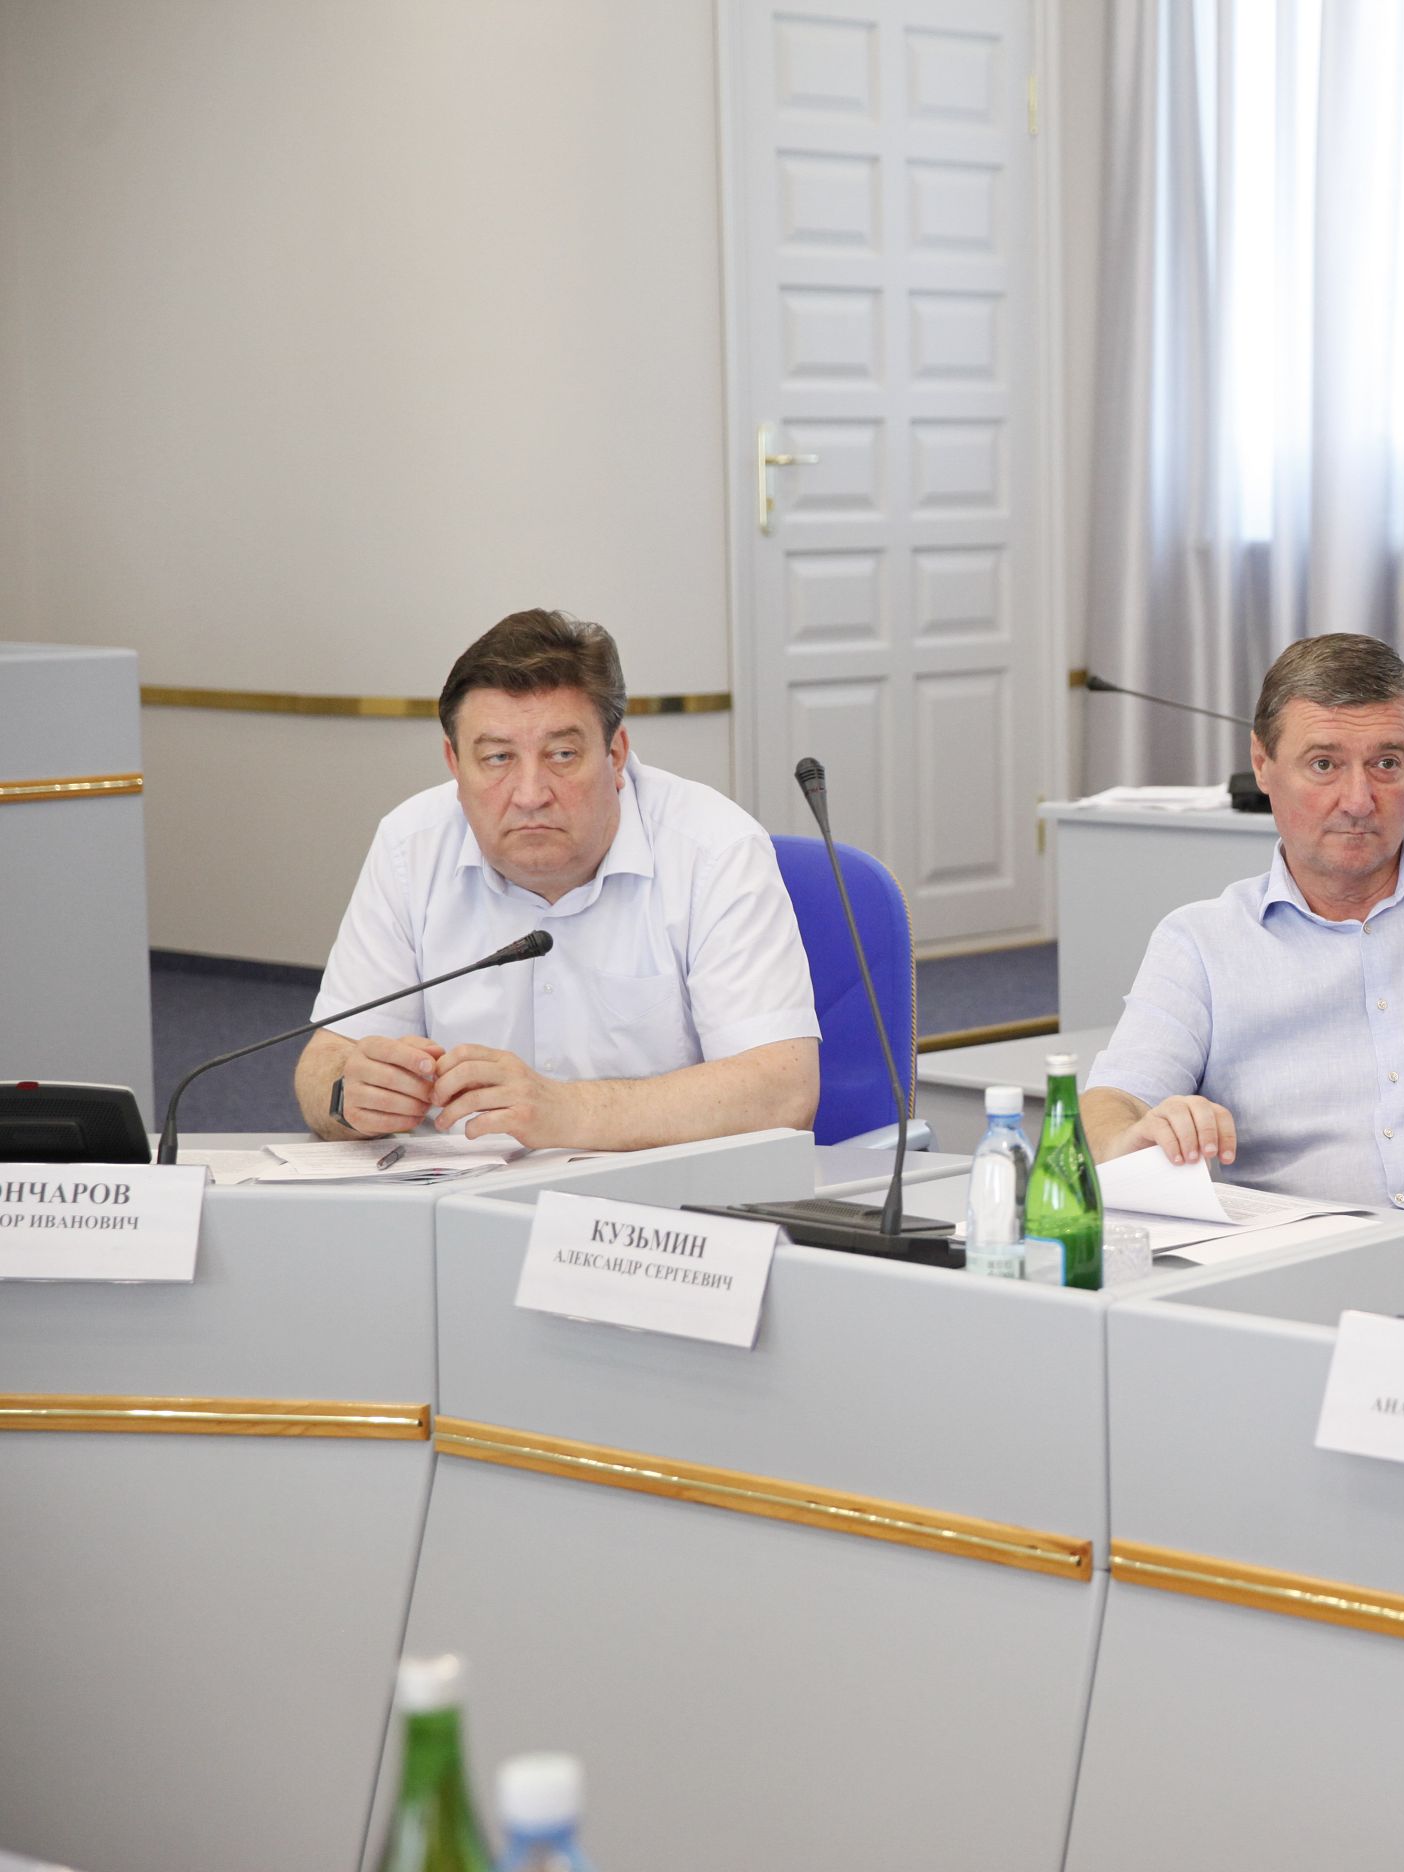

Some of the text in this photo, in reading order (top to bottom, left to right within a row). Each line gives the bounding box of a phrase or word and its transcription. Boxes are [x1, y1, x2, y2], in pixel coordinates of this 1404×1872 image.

[0, 1181, 131, 1205] НЧАРОВ
[30, 1214, 140, 1231] ИВАНОВИЧ
[590, 1219, 708, 1259] КУЗЬМИН
[553, 1249, 734, 1292] АЛЕКСАНДР СЕРГЕЕВИЧ
